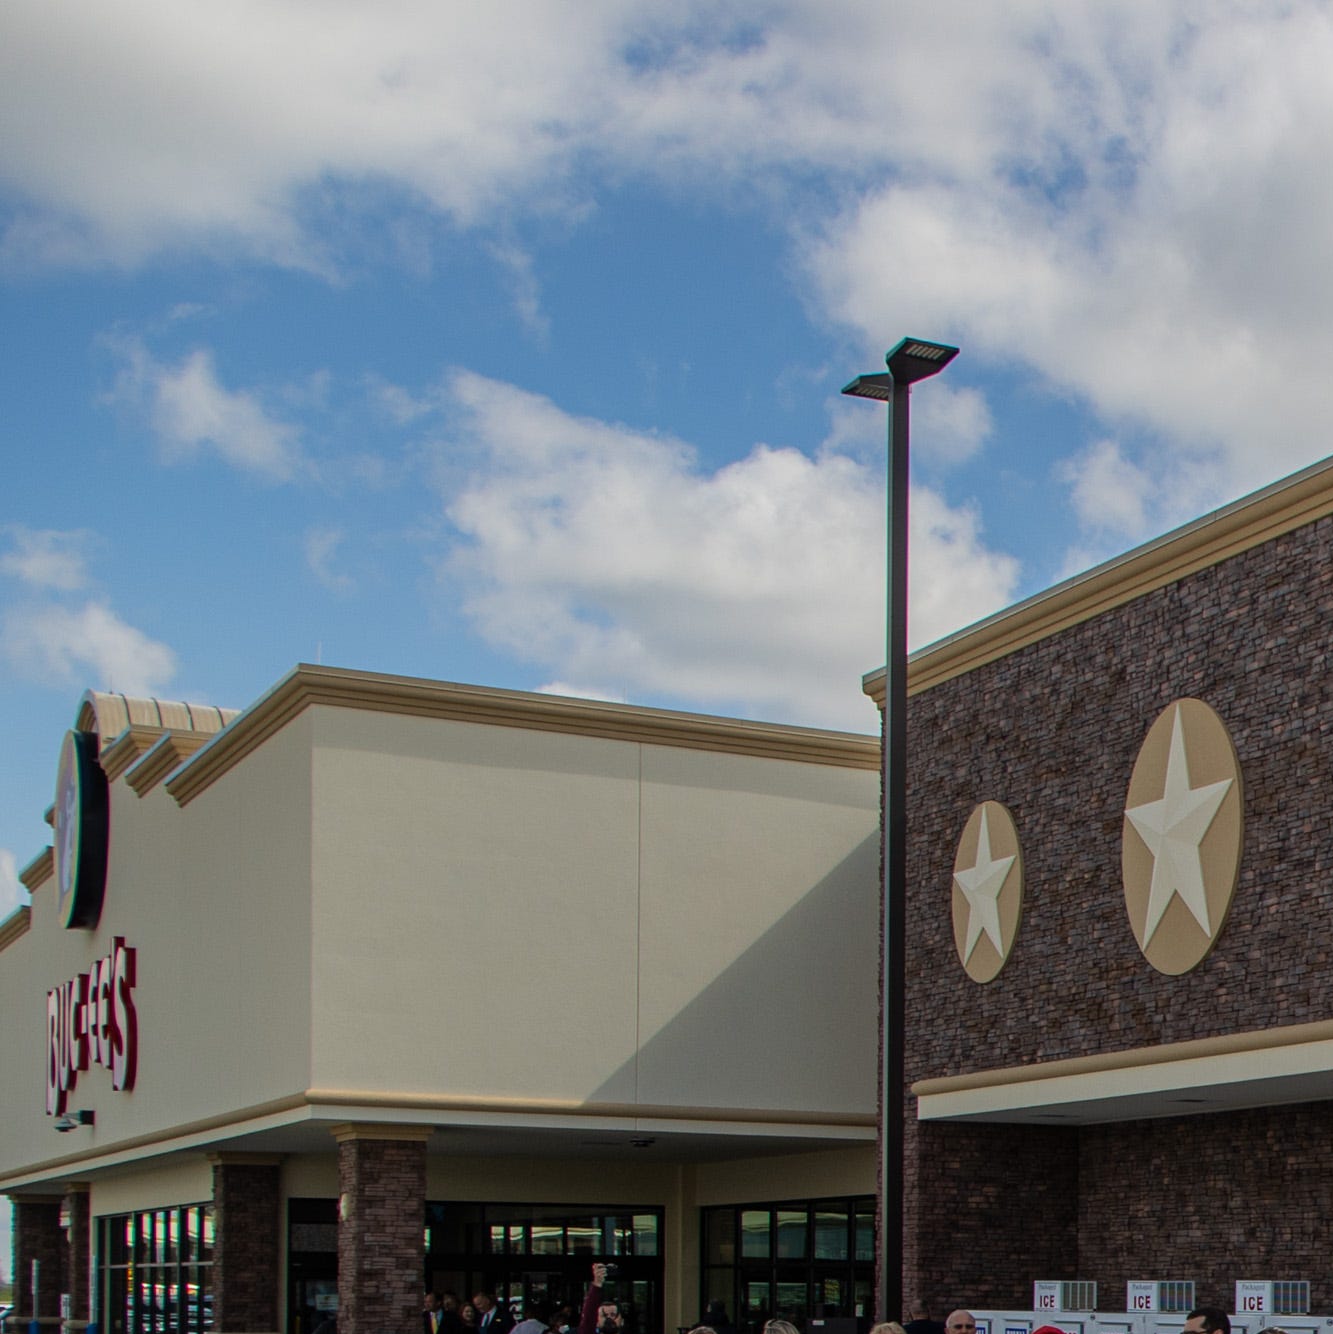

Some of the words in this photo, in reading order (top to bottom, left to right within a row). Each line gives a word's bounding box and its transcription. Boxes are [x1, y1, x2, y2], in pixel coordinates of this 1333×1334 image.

[1039, 1295, 1055, 1308] ICE
[1133, 1295, 1151, 1309] ICE
[1243, 1296, 1263, 1311] ICE
